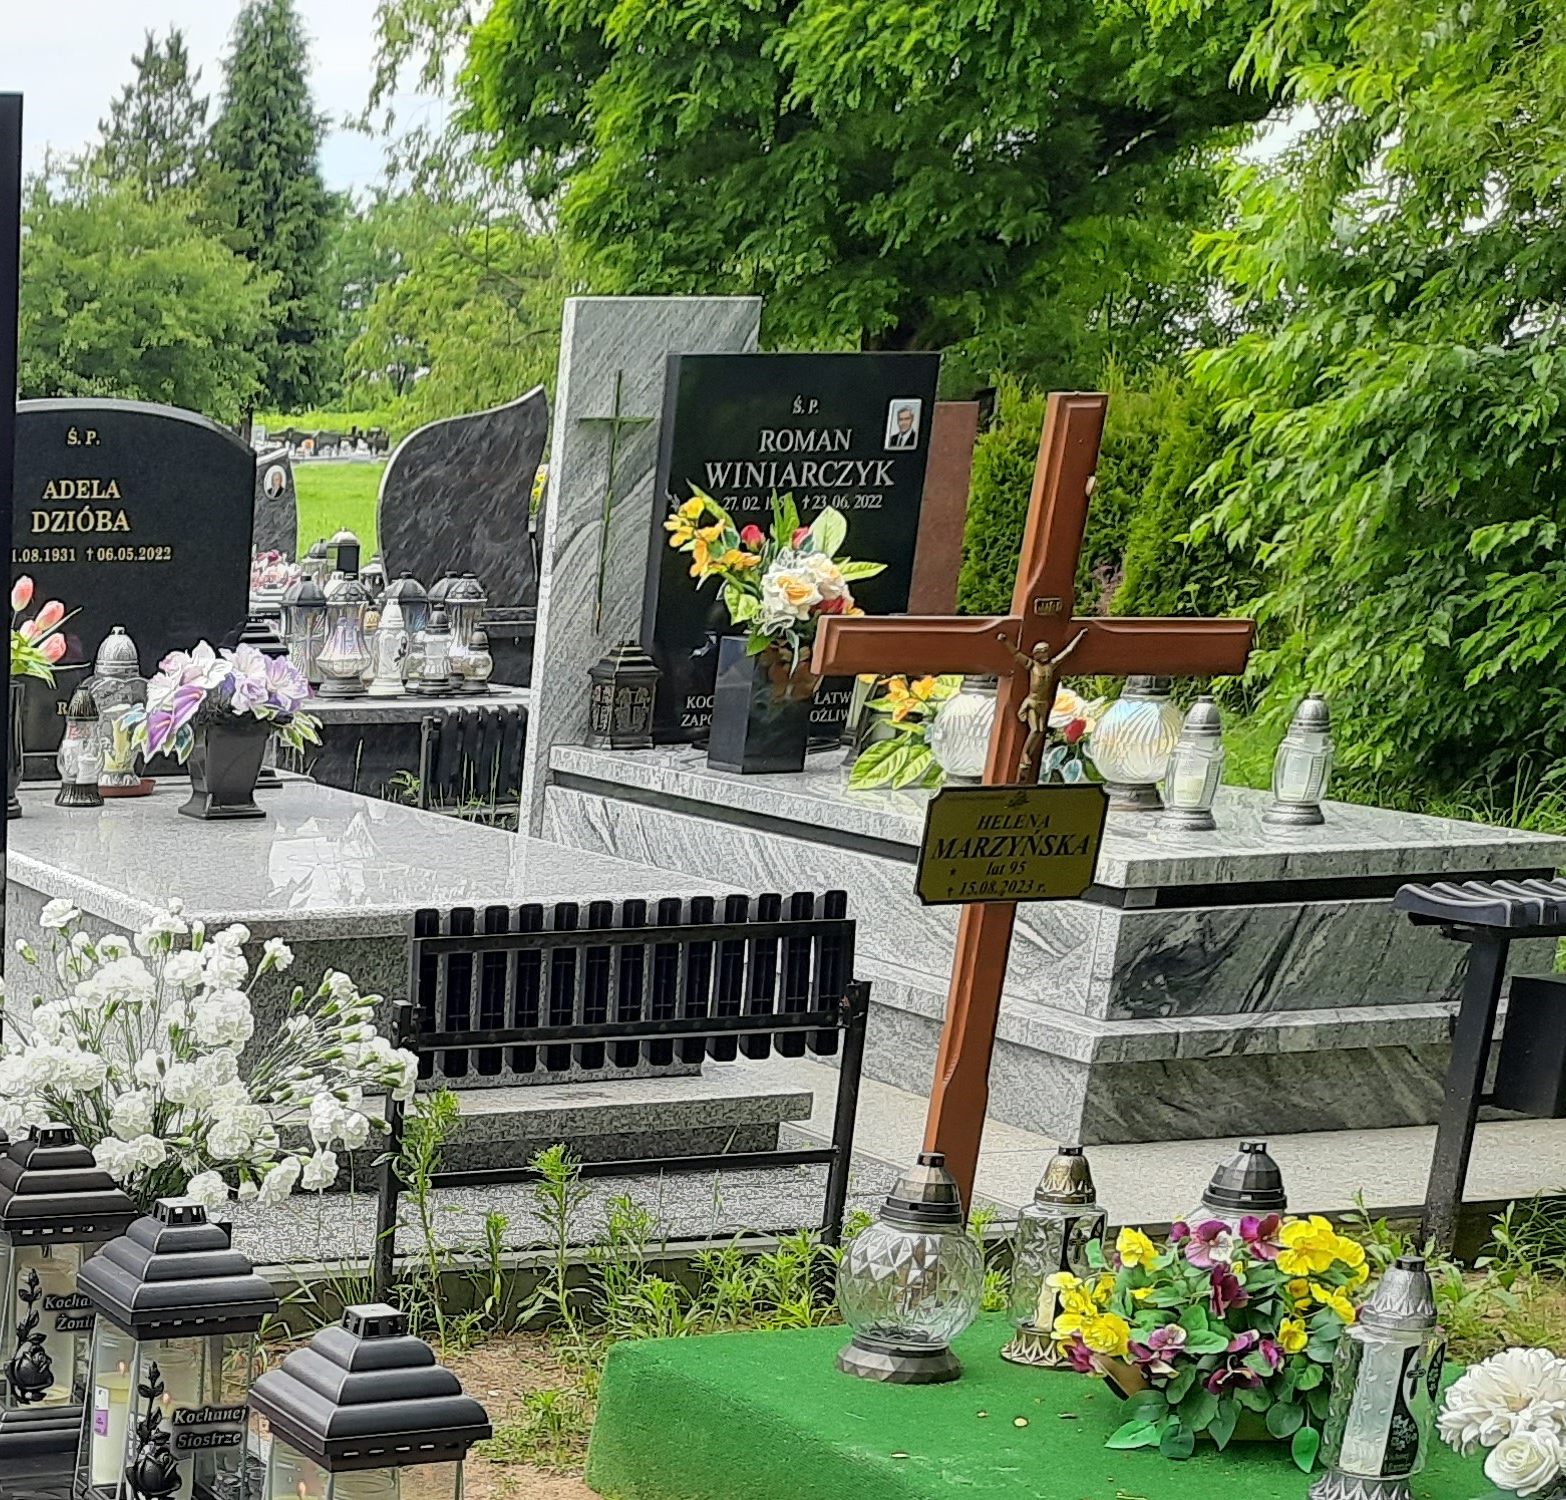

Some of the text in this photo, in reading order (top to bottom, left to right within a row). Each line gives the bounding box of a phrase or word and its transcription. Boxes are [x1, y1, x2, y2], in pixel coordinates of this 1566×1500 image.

[758, 428, 852, 453] ROMAN
[704, 459, 895, 489] WINIARCZYK
[42, 479, 122, 499] ADELA
[31, 505, 131, 533] DZIÓBA
[11, 546, 172, 563] 1.08.1931 06.05.2022
[977, 814, 1051, 831] HELENA
[931, 829, 1091, 860] MARZYŃSKA
[986, 860, 1027, 875] lat 95
[173, 1404, 247, 1425] Kochanej
[177, 1432, 241, 1449] Siostrze
